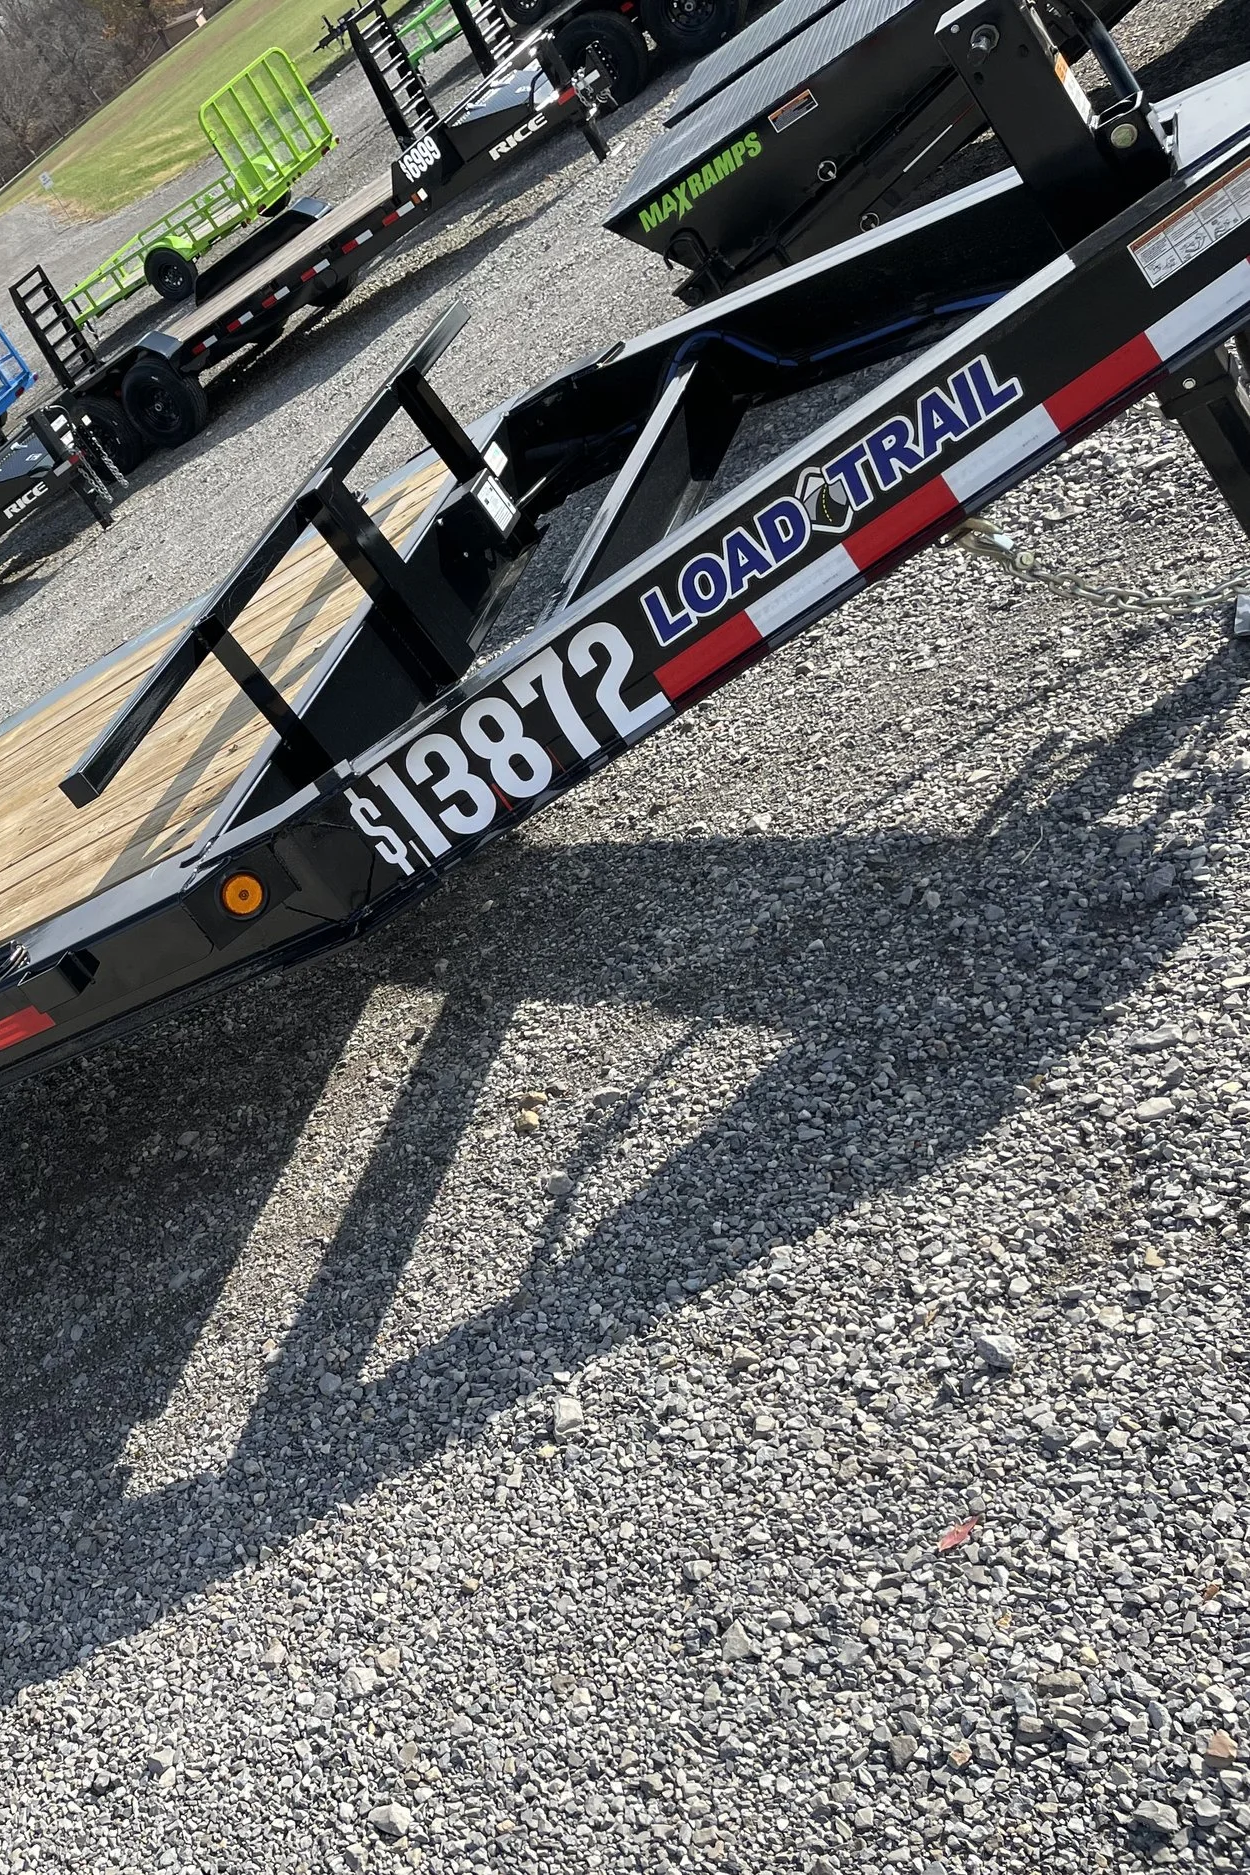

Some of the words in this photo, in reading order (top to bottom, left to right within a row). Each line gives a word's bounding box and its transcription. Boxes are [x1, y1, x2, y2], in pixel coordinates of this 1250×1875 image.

[398, 135, 441, 183] $6999
[488, 112, 548, 161] RICE
[3, 481, 48, 519] RICE
[641, 495, 812, 648] LOAD
[821, 353, 1023, 510] TRAIL
[343, 622, 672, 876] $13872
